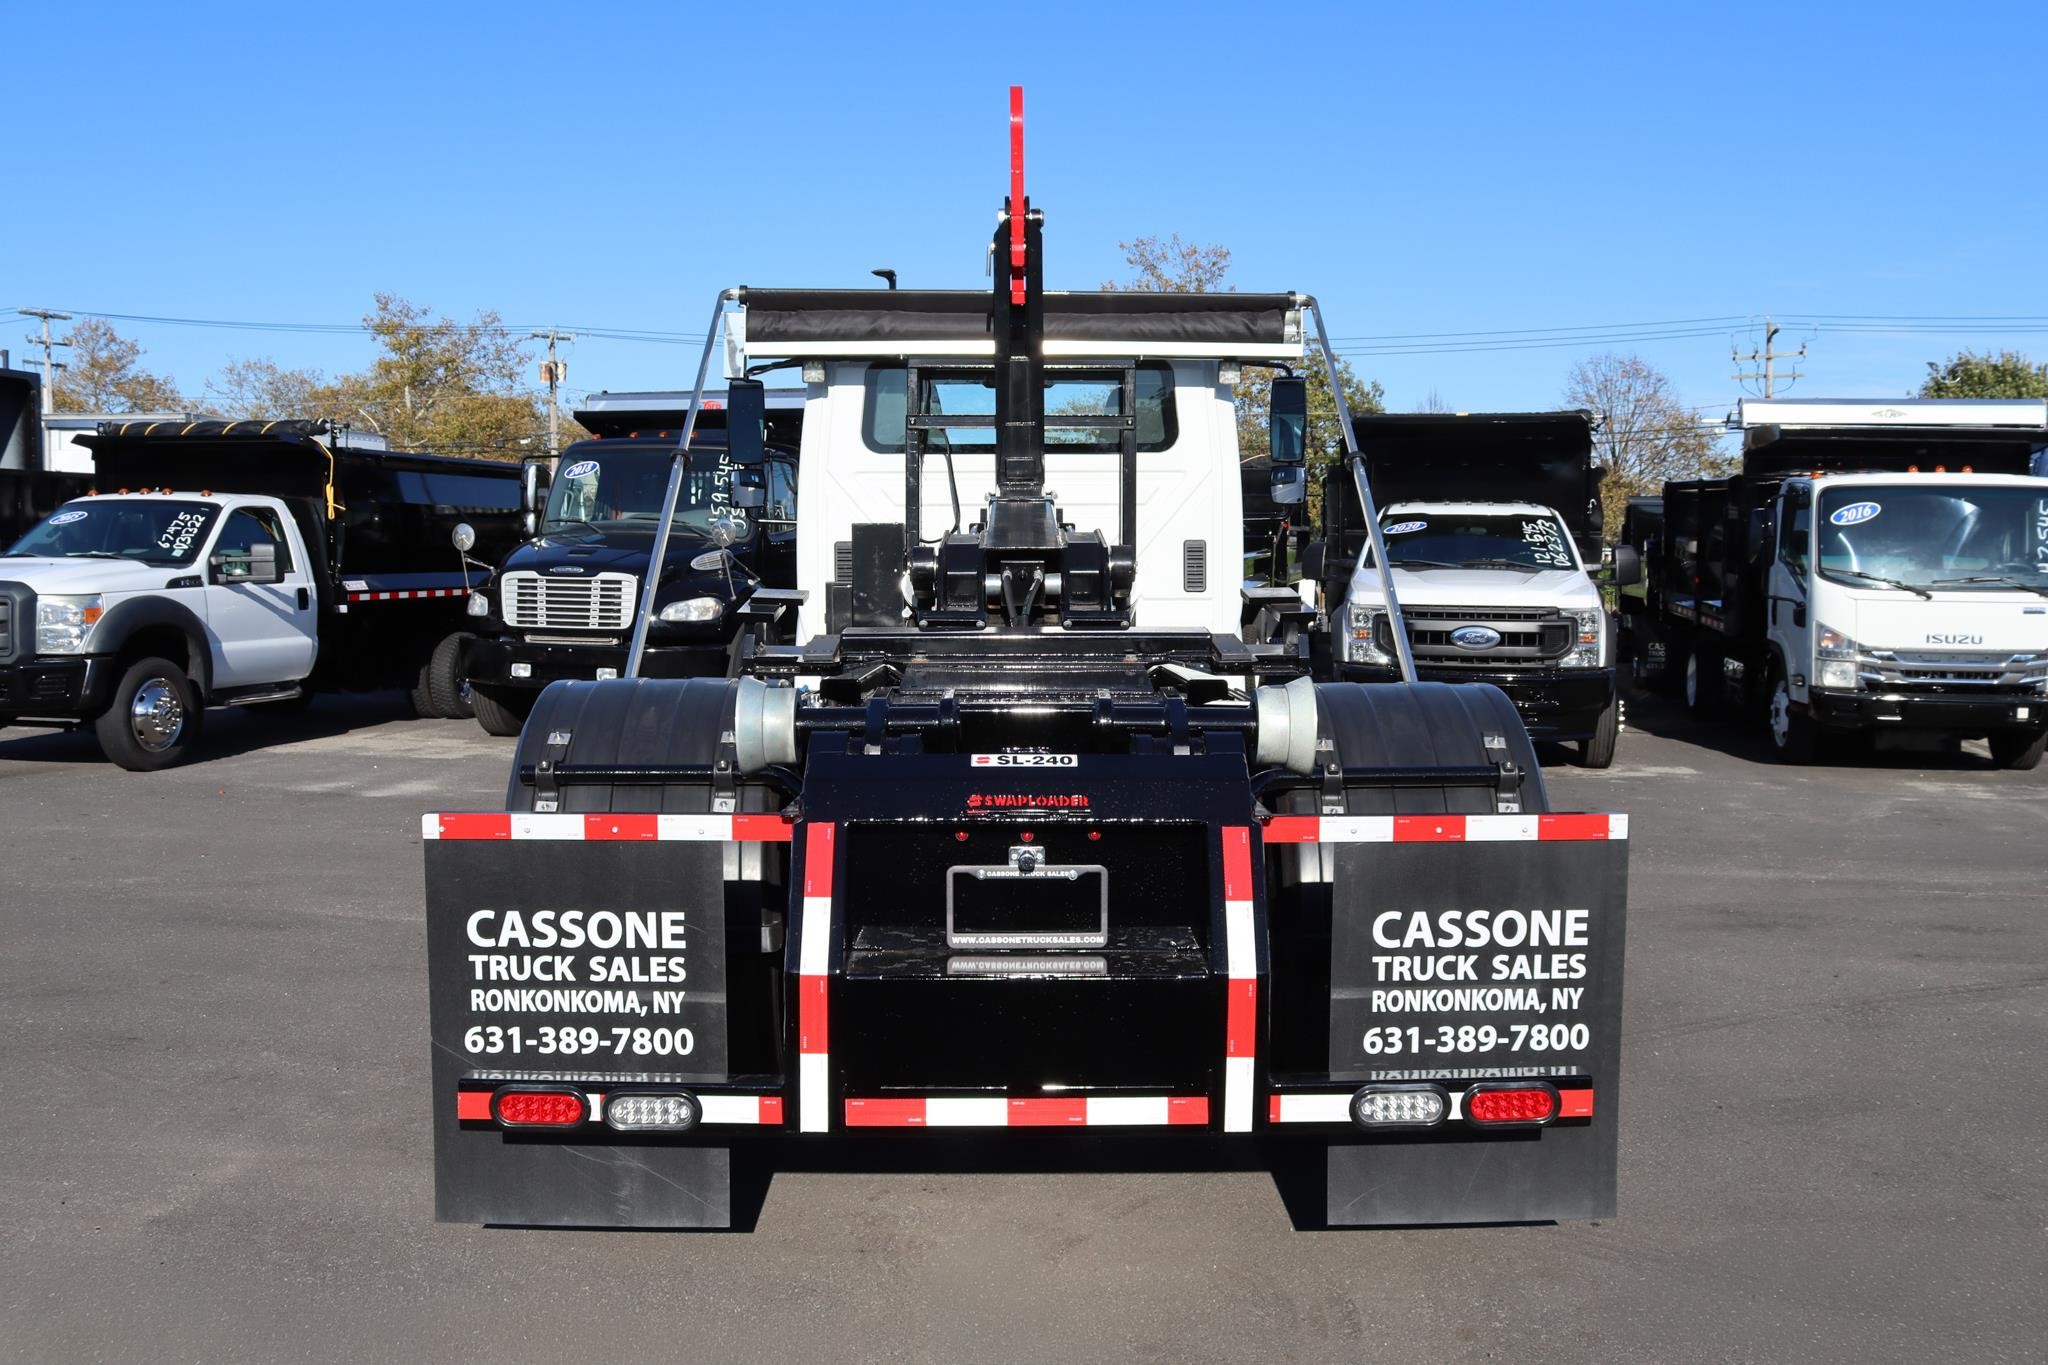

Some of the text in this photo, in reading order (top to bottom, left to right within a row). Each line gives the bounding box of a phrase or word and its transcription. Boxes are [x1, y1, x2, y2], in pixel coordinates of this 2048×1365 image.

[1842, 504, 1873, 523] 2016
[173, 514, 206, 550] 031322
[1926, 633, 1984, 645] ISUZU
[997, 755, 1073, 765] SL-240
[985, 794, 1089, 807] SWAPLOADER
[466, 909, 687, 949] CASSONE
[951, 936, 1104, 944] WWW.CASSONETRUCKSALES.COM
[1371, 909, 1589, 949] CASSONE
[468, 955, 687, 983] TRUCK SALES
[1372, 953, 1587, 982] TRUCK SALES
[470, 988, 686, 1016] RONKONKOMA, NY
[1371, 987, 1585, 1014] RONKONKOMA, NY
[464, 1026, 694, 1055] 631-389-7800
[1363, 1023, 1590, 1055] 631-389-7800
